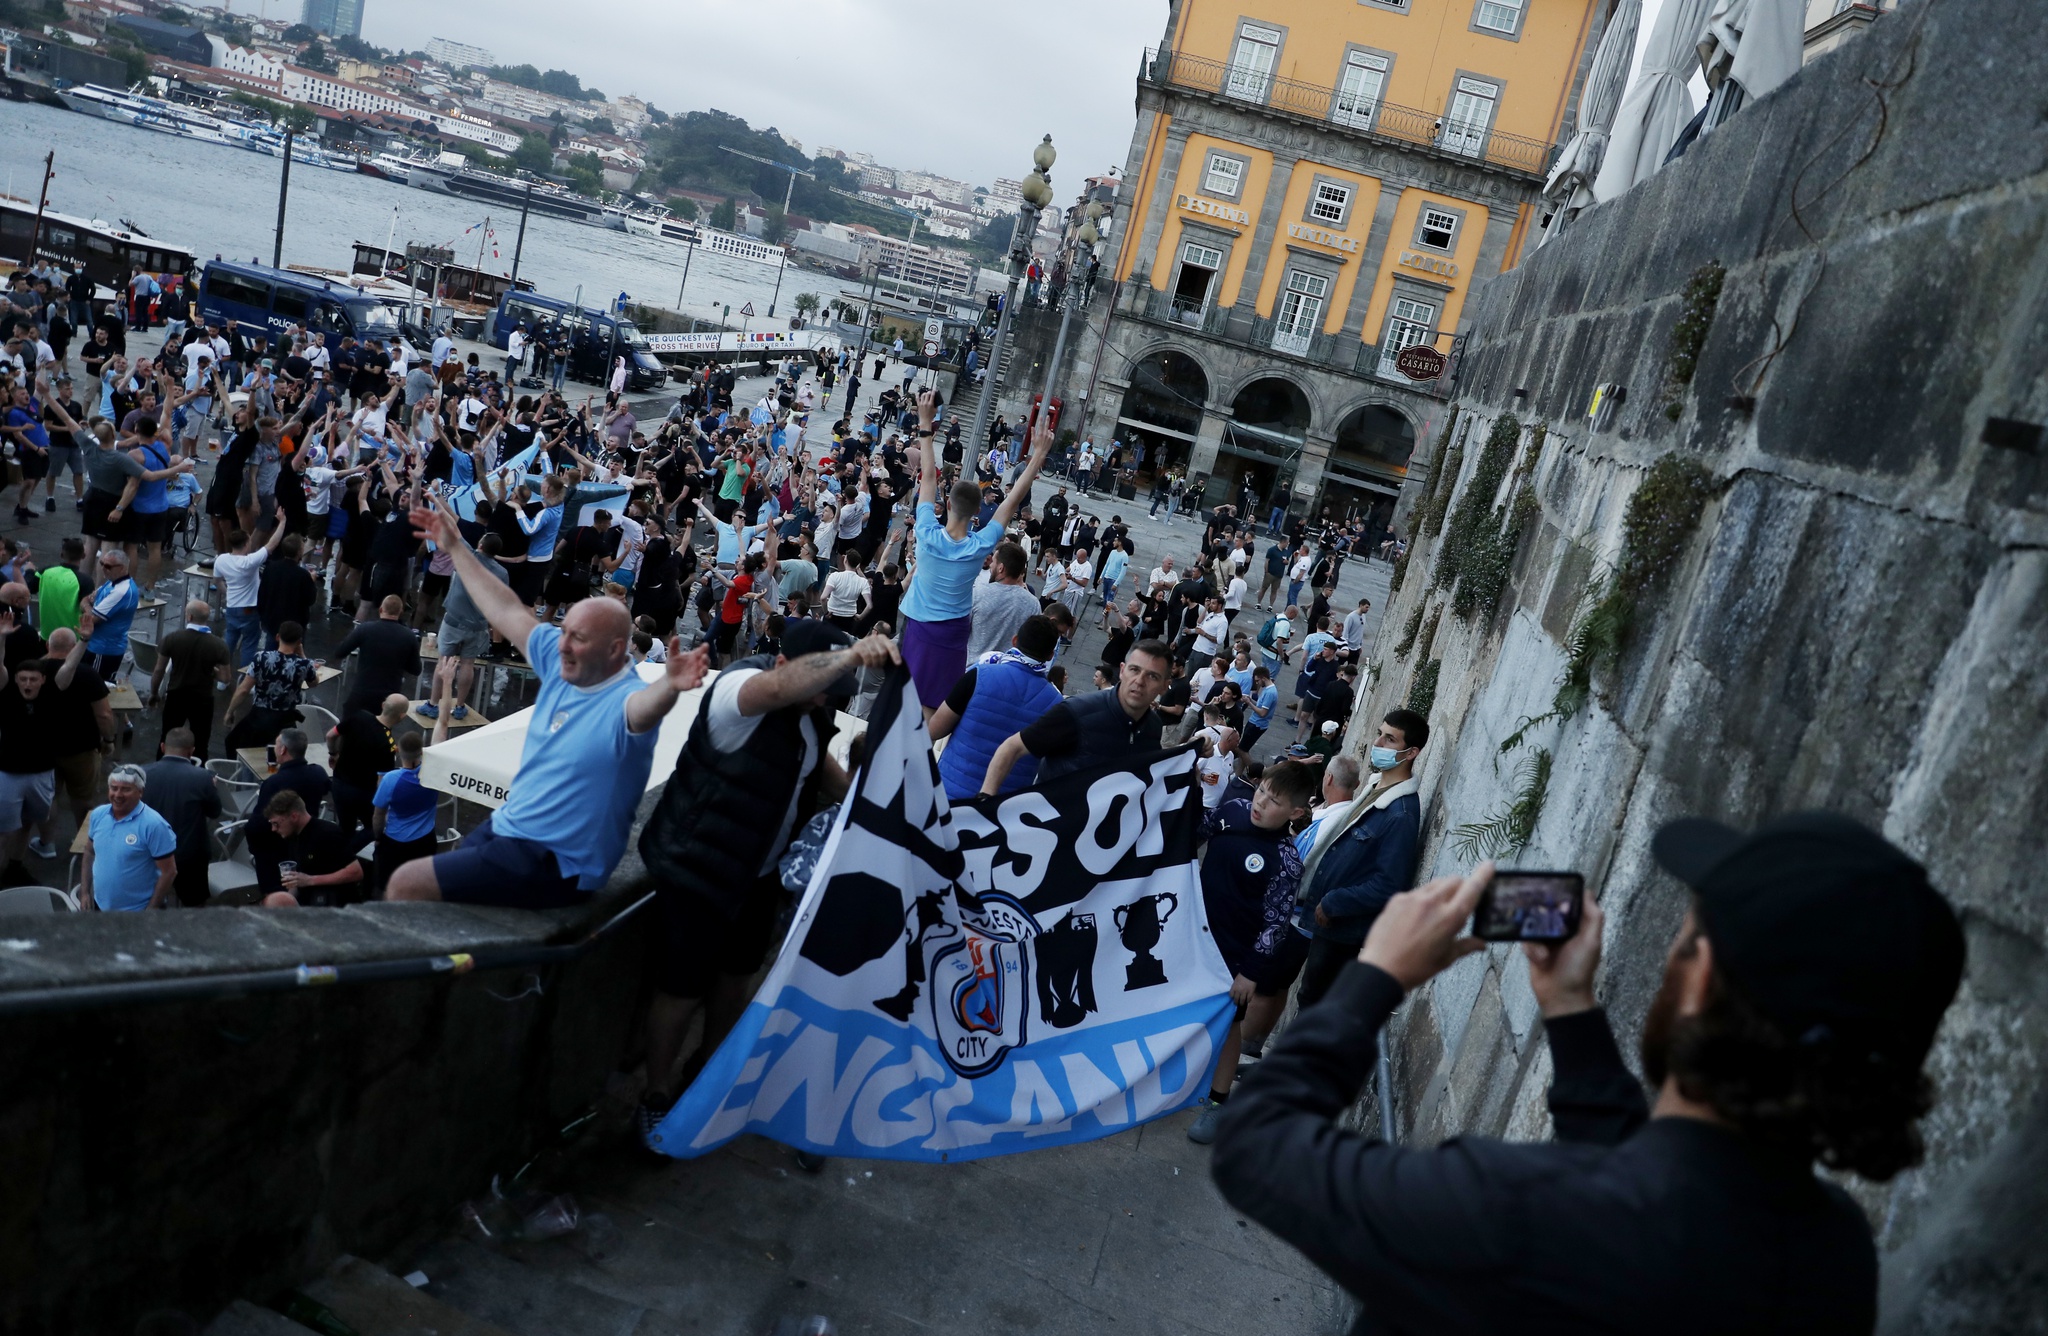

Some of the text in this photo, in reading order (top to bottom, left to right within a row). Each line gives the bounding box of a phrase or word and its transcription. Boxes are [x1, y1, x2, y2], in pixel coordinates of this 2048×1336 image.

[1176, 193, 1249, 226] PESTANA
[1288, 222, 1359, 254] VINTAGE
[1399, 251, 1459, 278] PORTO
[267, 316, 297, 329] POLÍC
[1401, 357, 1440, 372] CASARIO
[449, 772, 492, 797] SUPER
[1075, 749, 1198, 875] OF
[1005, 960, 1018, 973] 94
[956, 1036, 990, 1059] CITY
[690, 1010, 1213, 1150] ENGLAND
